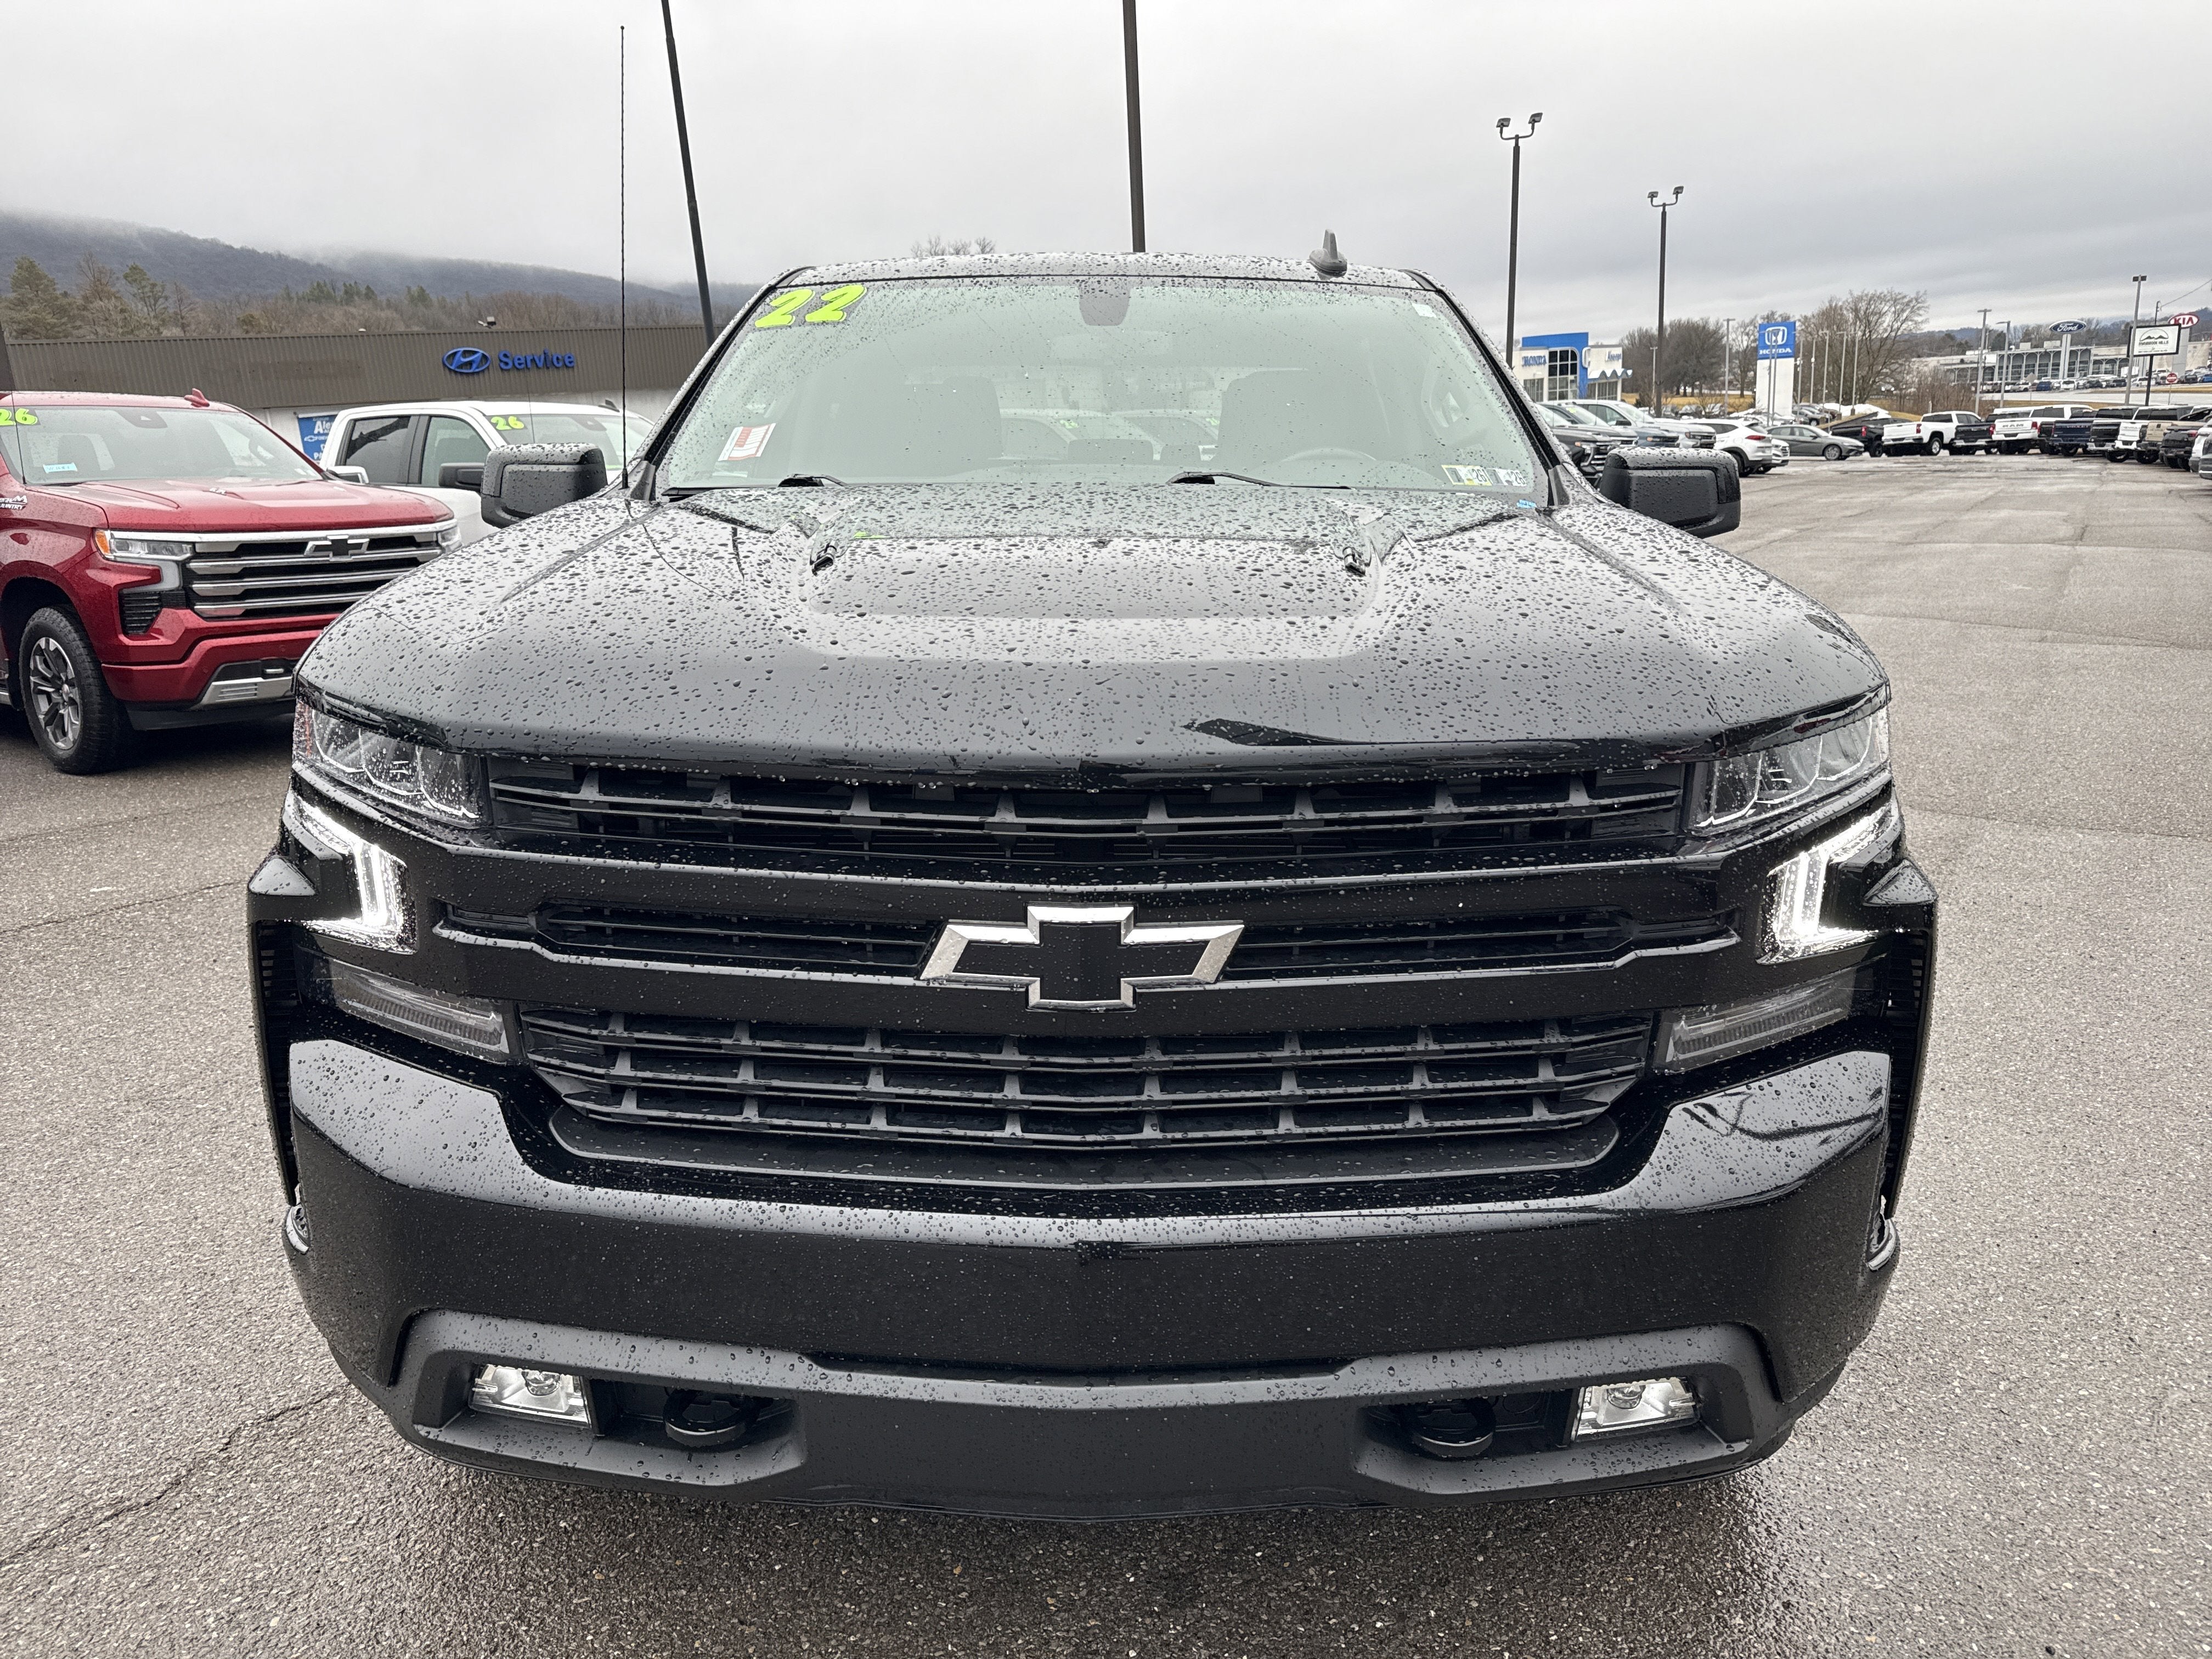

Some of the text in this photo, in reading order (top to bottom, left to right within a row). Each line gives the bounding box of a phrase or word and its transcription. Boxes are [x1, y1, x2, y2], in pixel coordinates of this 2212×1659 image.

[755, 284, 867, 328] 22
[2057, 323, 2079, 332] Ford
[2174, 317, 2194, 325] KIA
[498, 348, 575, 370] Service
[0, 408, 38, 426] 26
[490, 416, 524, 430] 26
